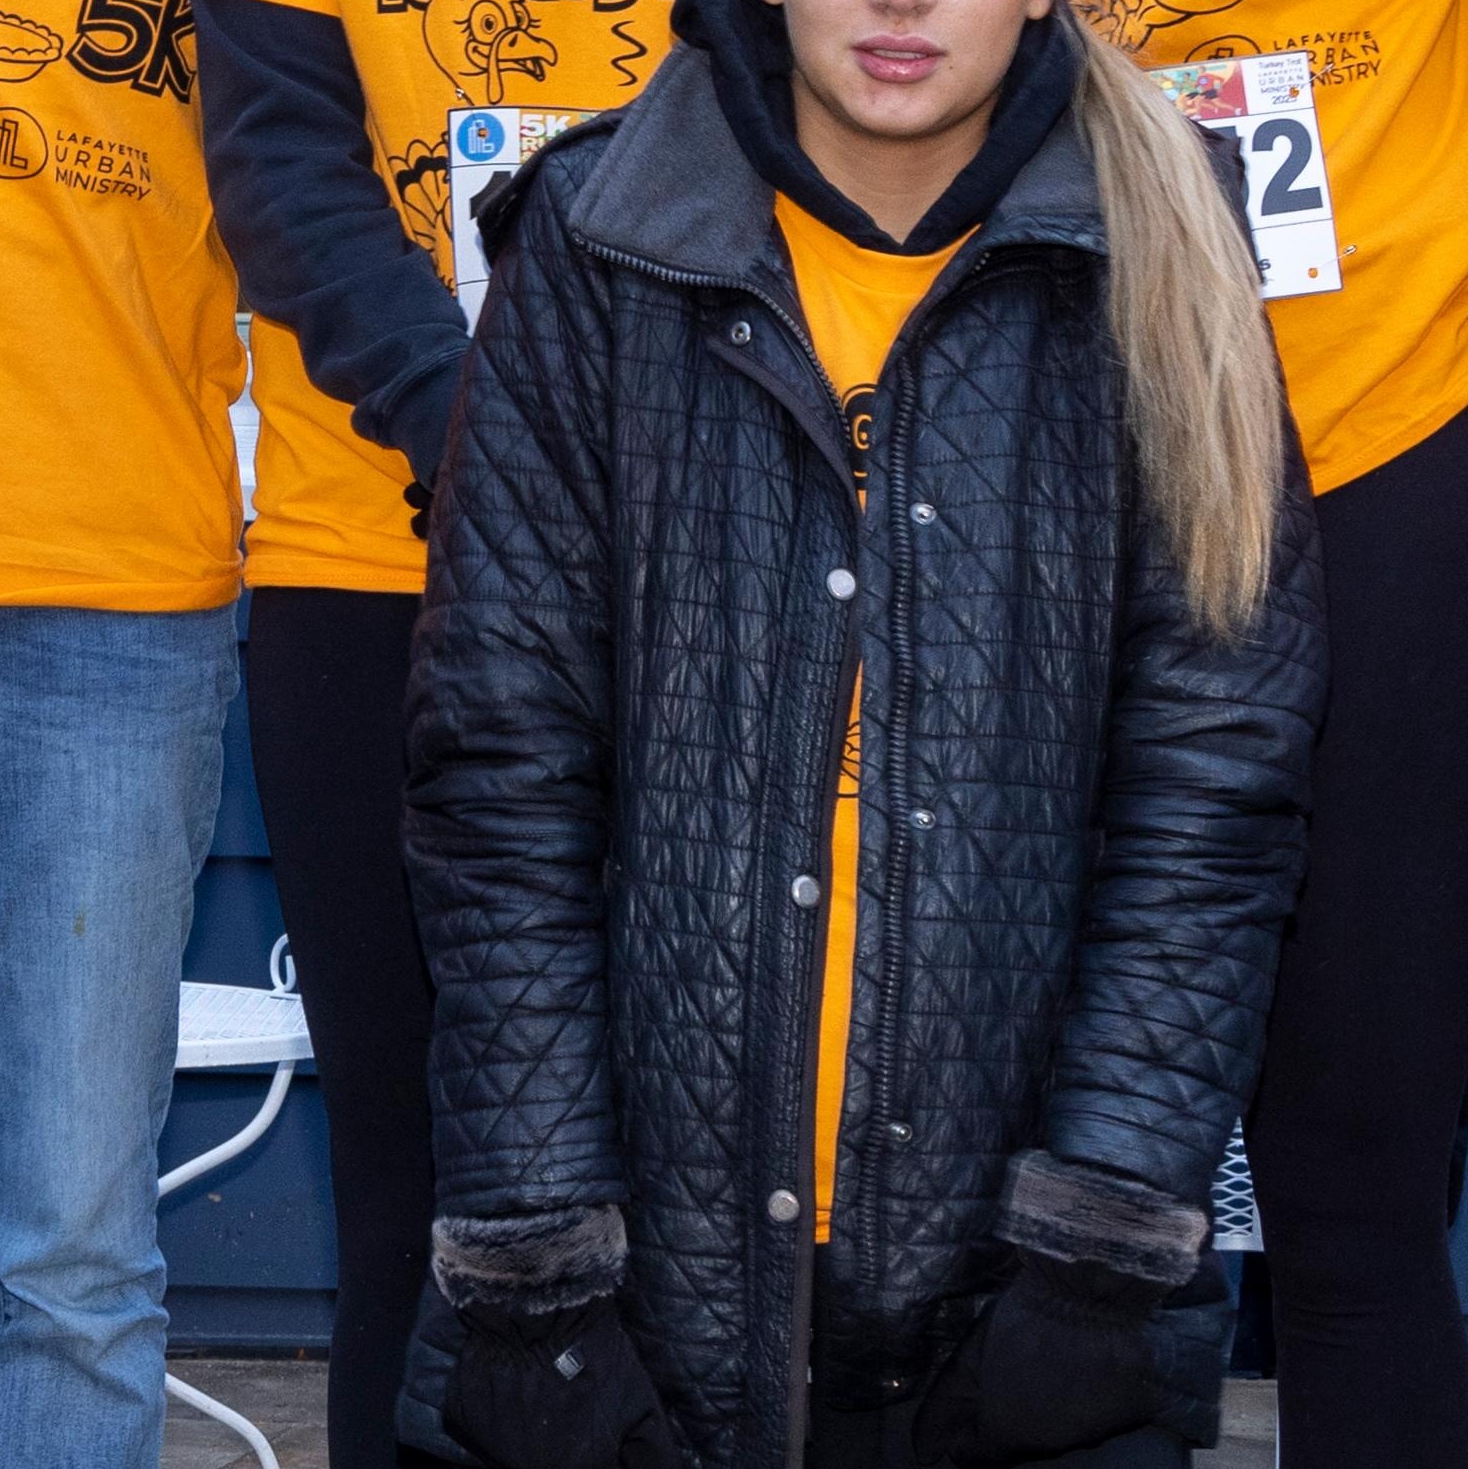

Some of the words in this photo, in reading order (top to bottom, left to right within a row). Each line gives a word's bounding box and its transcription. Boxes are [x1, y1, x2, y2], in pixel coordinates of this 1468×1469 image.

[1274, 31, 1372, 51] LAFAYETTE
[1308, 40, 1380, 65] RBAN
[56, 130, 149, 163] LAFAYETTE
[55, 145, 151, 183] URBAN
[55, 166, 152, 201] MINISTRY
